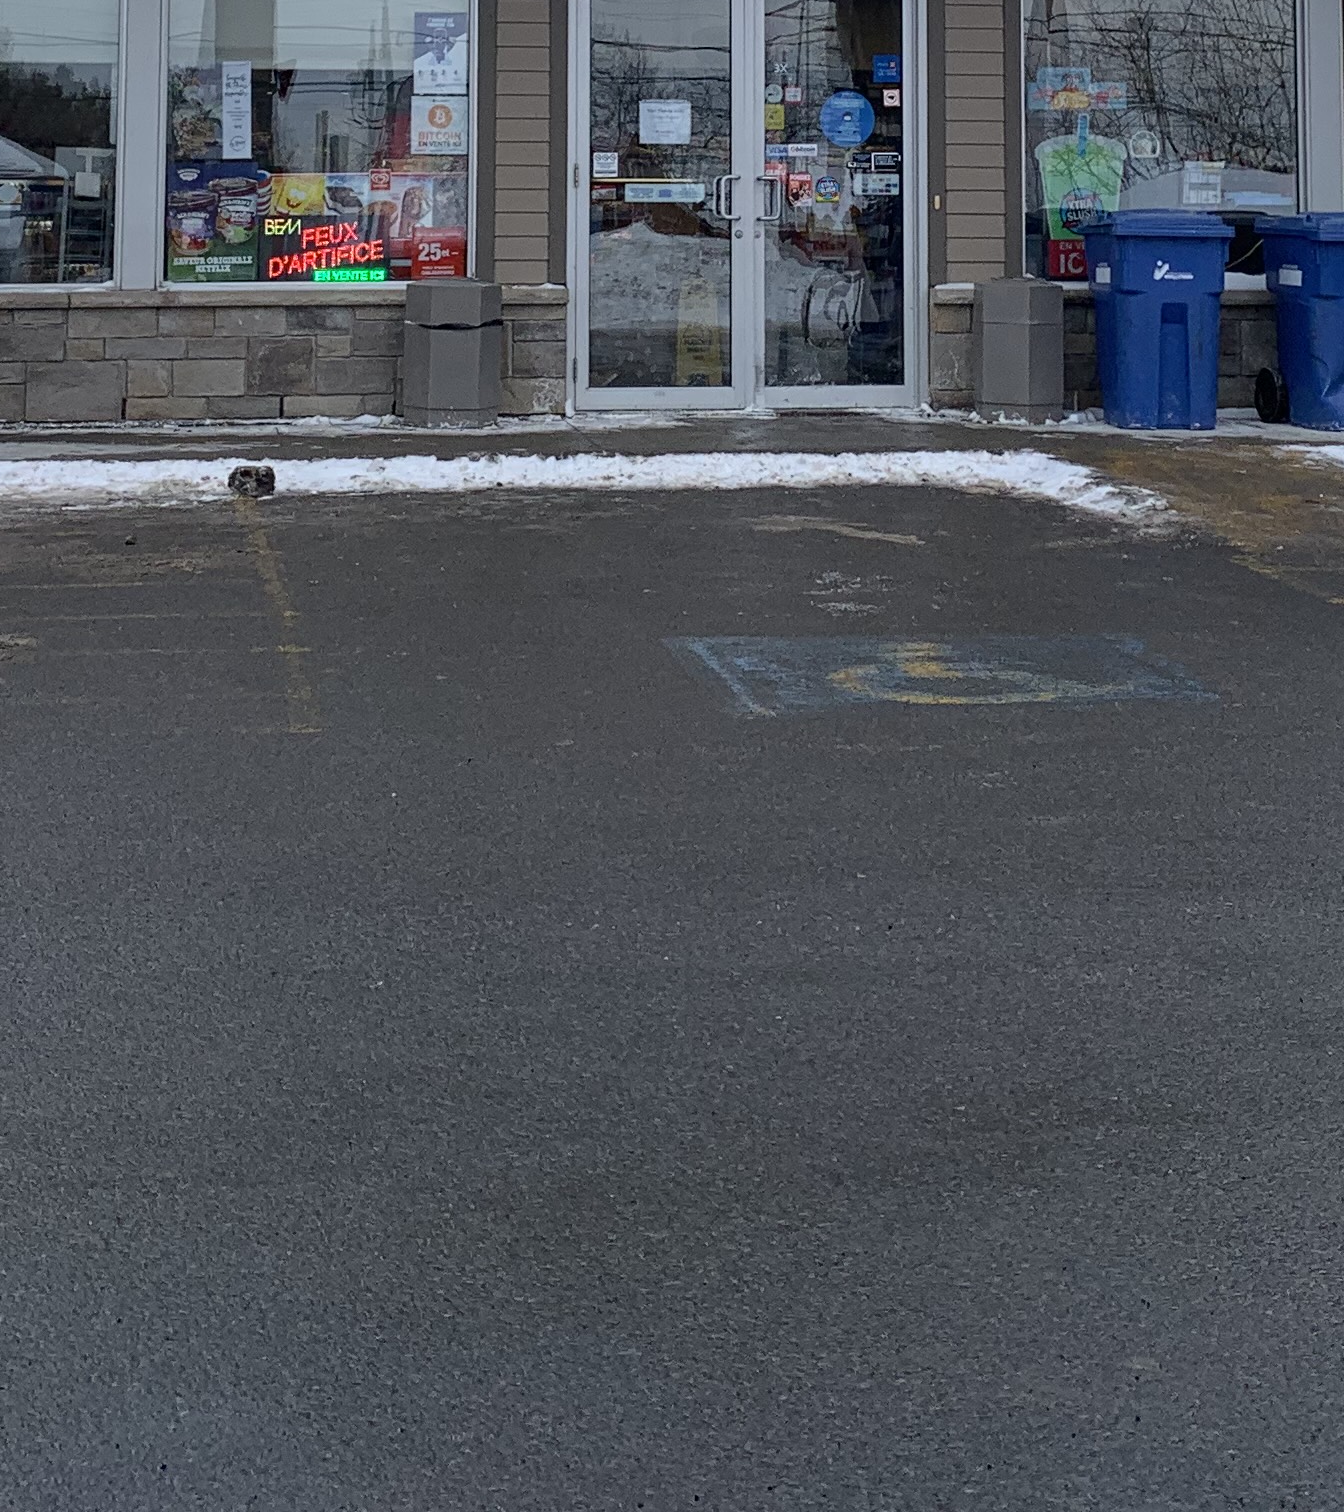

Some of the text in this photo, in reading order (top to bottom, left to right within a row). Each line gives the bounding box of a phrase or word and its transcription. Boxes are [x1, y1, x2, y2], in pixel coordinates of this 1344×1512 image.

[418, 131, 462, 141] BITCOIN
[302, 221, 359, 249] FEUX
[418, 242, 441, 261] 25
[1059, 242, 1072, 250] EN
[268, 239, 384, 279] D'ARTIFICE
[1059, 252, 1084, 274] IC
[314, 269, 385, 281] EN VENTE ICI
